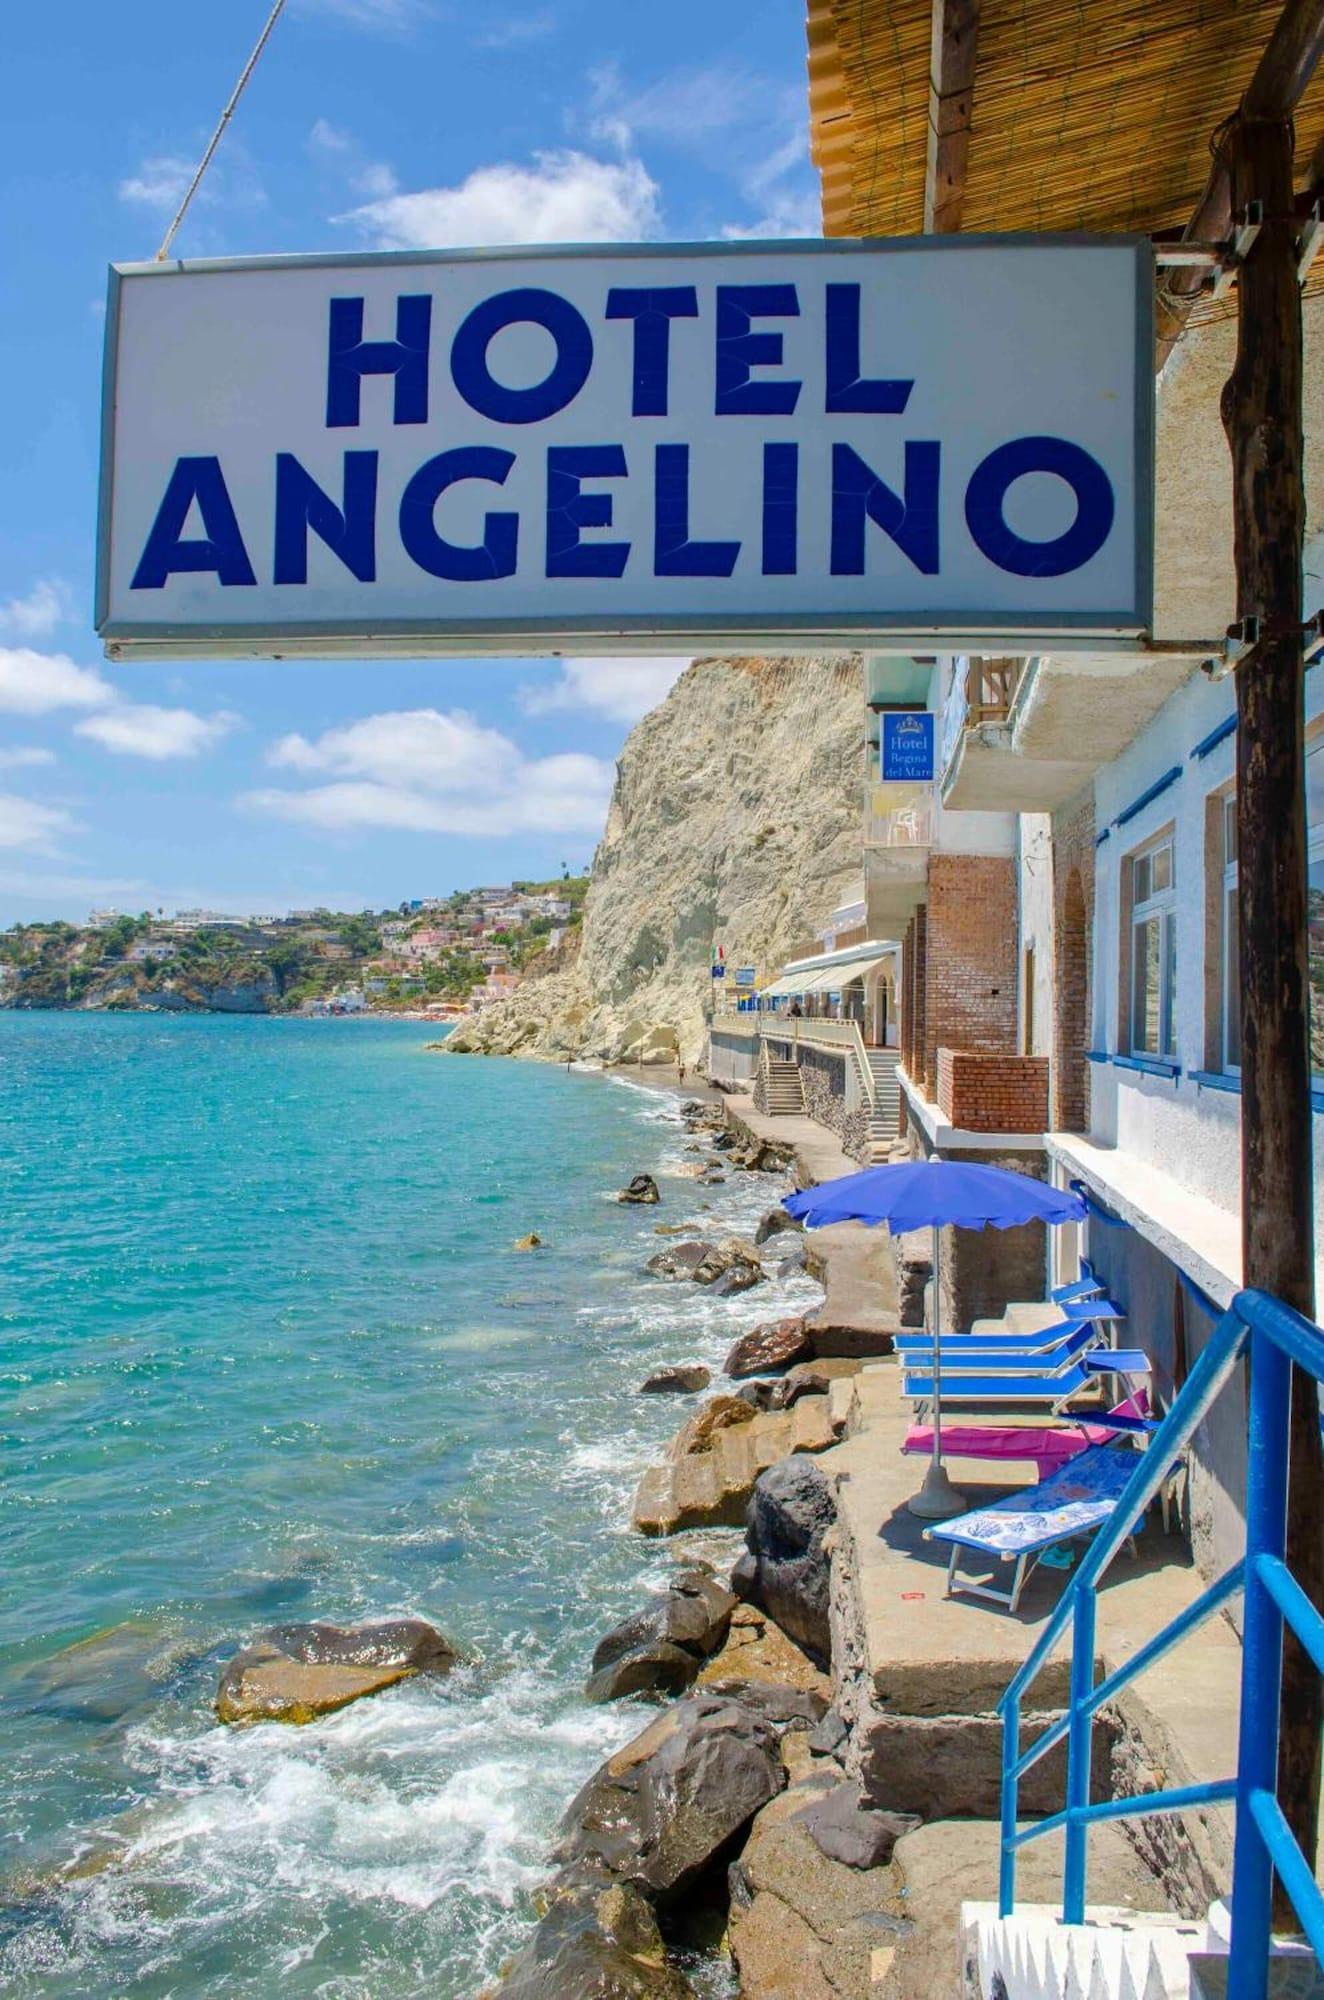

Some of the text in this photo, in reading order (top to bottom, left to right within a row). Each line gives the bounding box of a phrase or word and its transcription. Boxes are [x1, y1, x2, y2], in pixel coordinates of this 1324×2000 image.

[326, 283, 915, 428] HOTEL
[129, 435, 1115, 590] ANGELINO
[891, 736, 927, 750] Hotel
[891, 752, 927, 764] Regina
[886, 767, 931, 777] del Mare
